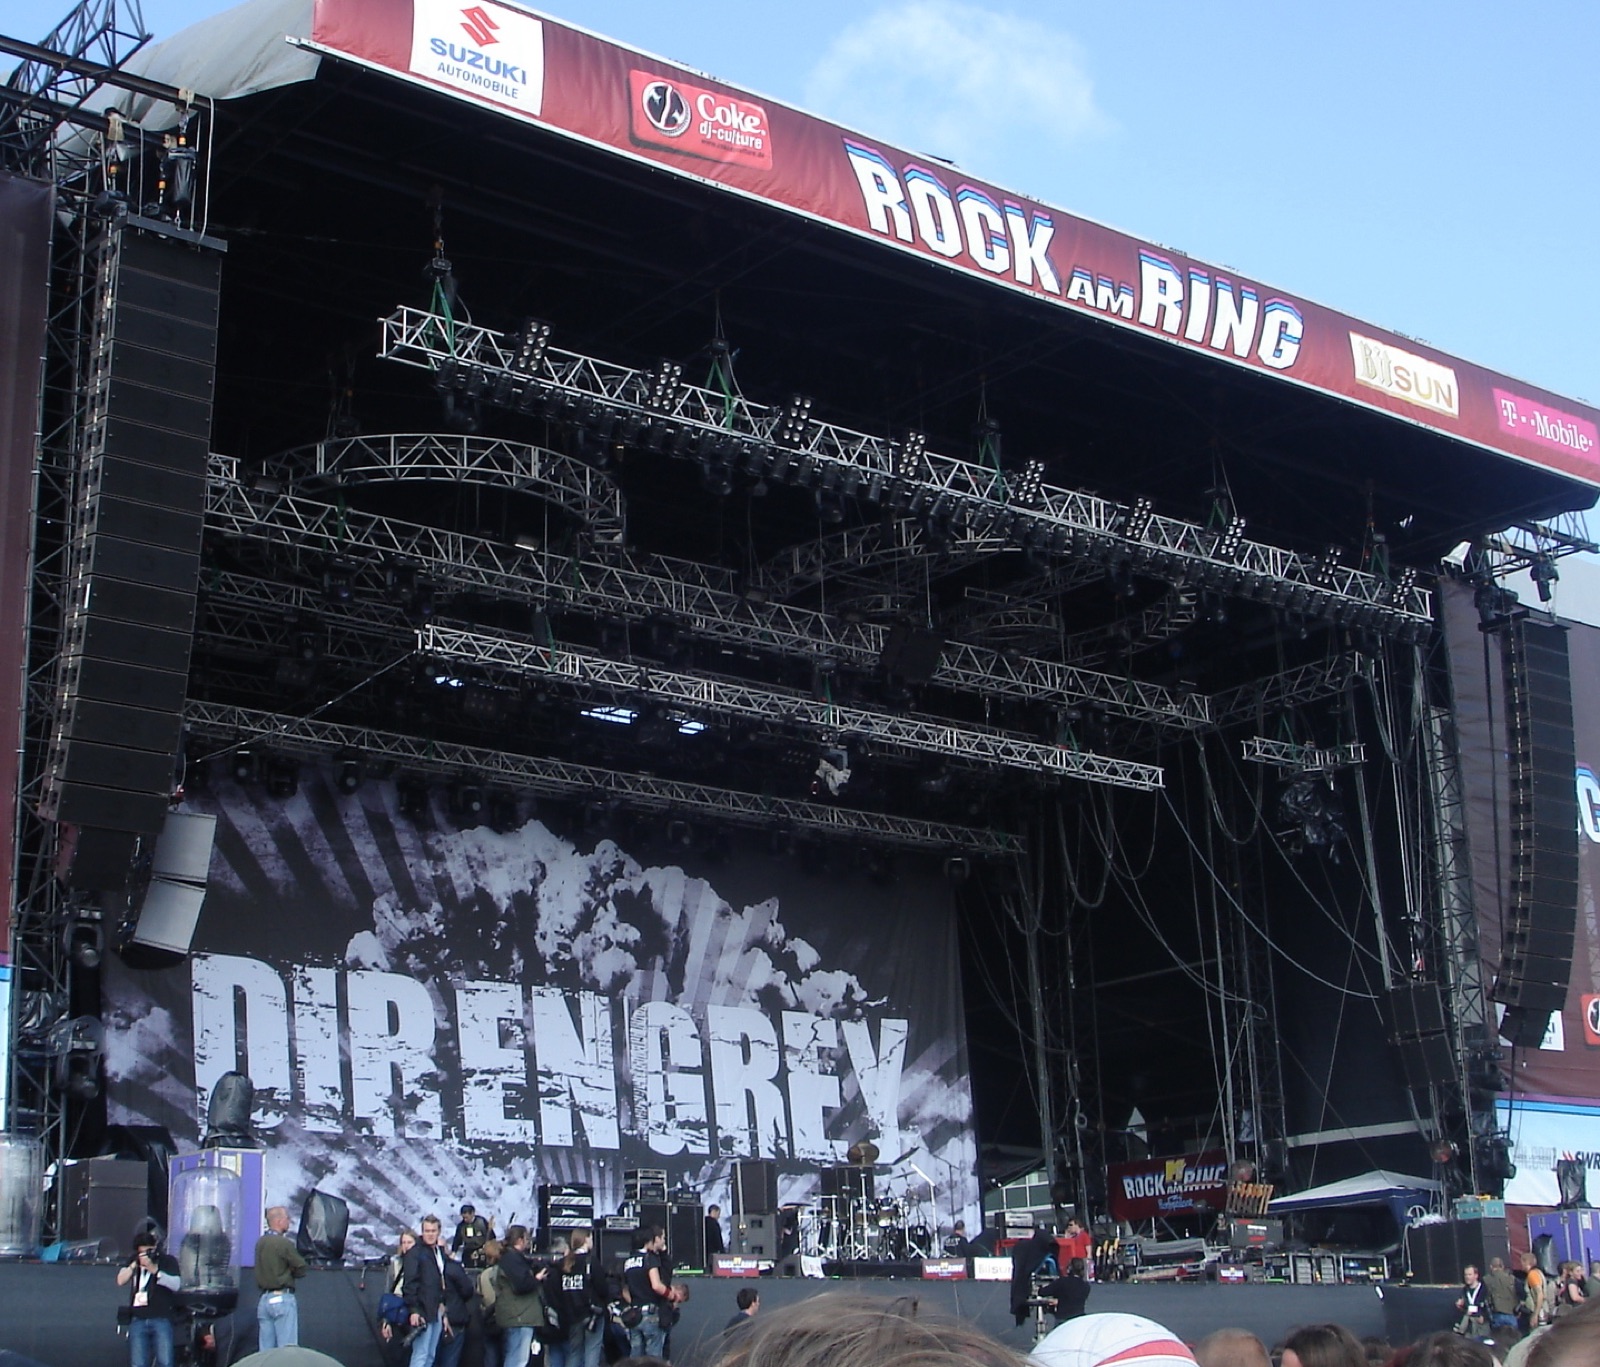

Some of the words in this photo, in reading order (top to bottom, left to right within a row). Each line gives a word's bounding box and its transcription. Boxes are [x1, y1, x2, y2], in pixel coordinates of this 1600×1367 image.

[430, 37, 526, 85] SUZUKI
[437, 61, 519, 99] AUTOMOBILE
[696, 93, 762, 134] Coke
[699, 120, 763, 150] dj-culture
[843, 139, 1061, 296] ROCK
[1066, 268, 1134, 321] AM
[1138, 250, 1304, 370] RING
[1122, 1174, 1166, 1200] ROCK
